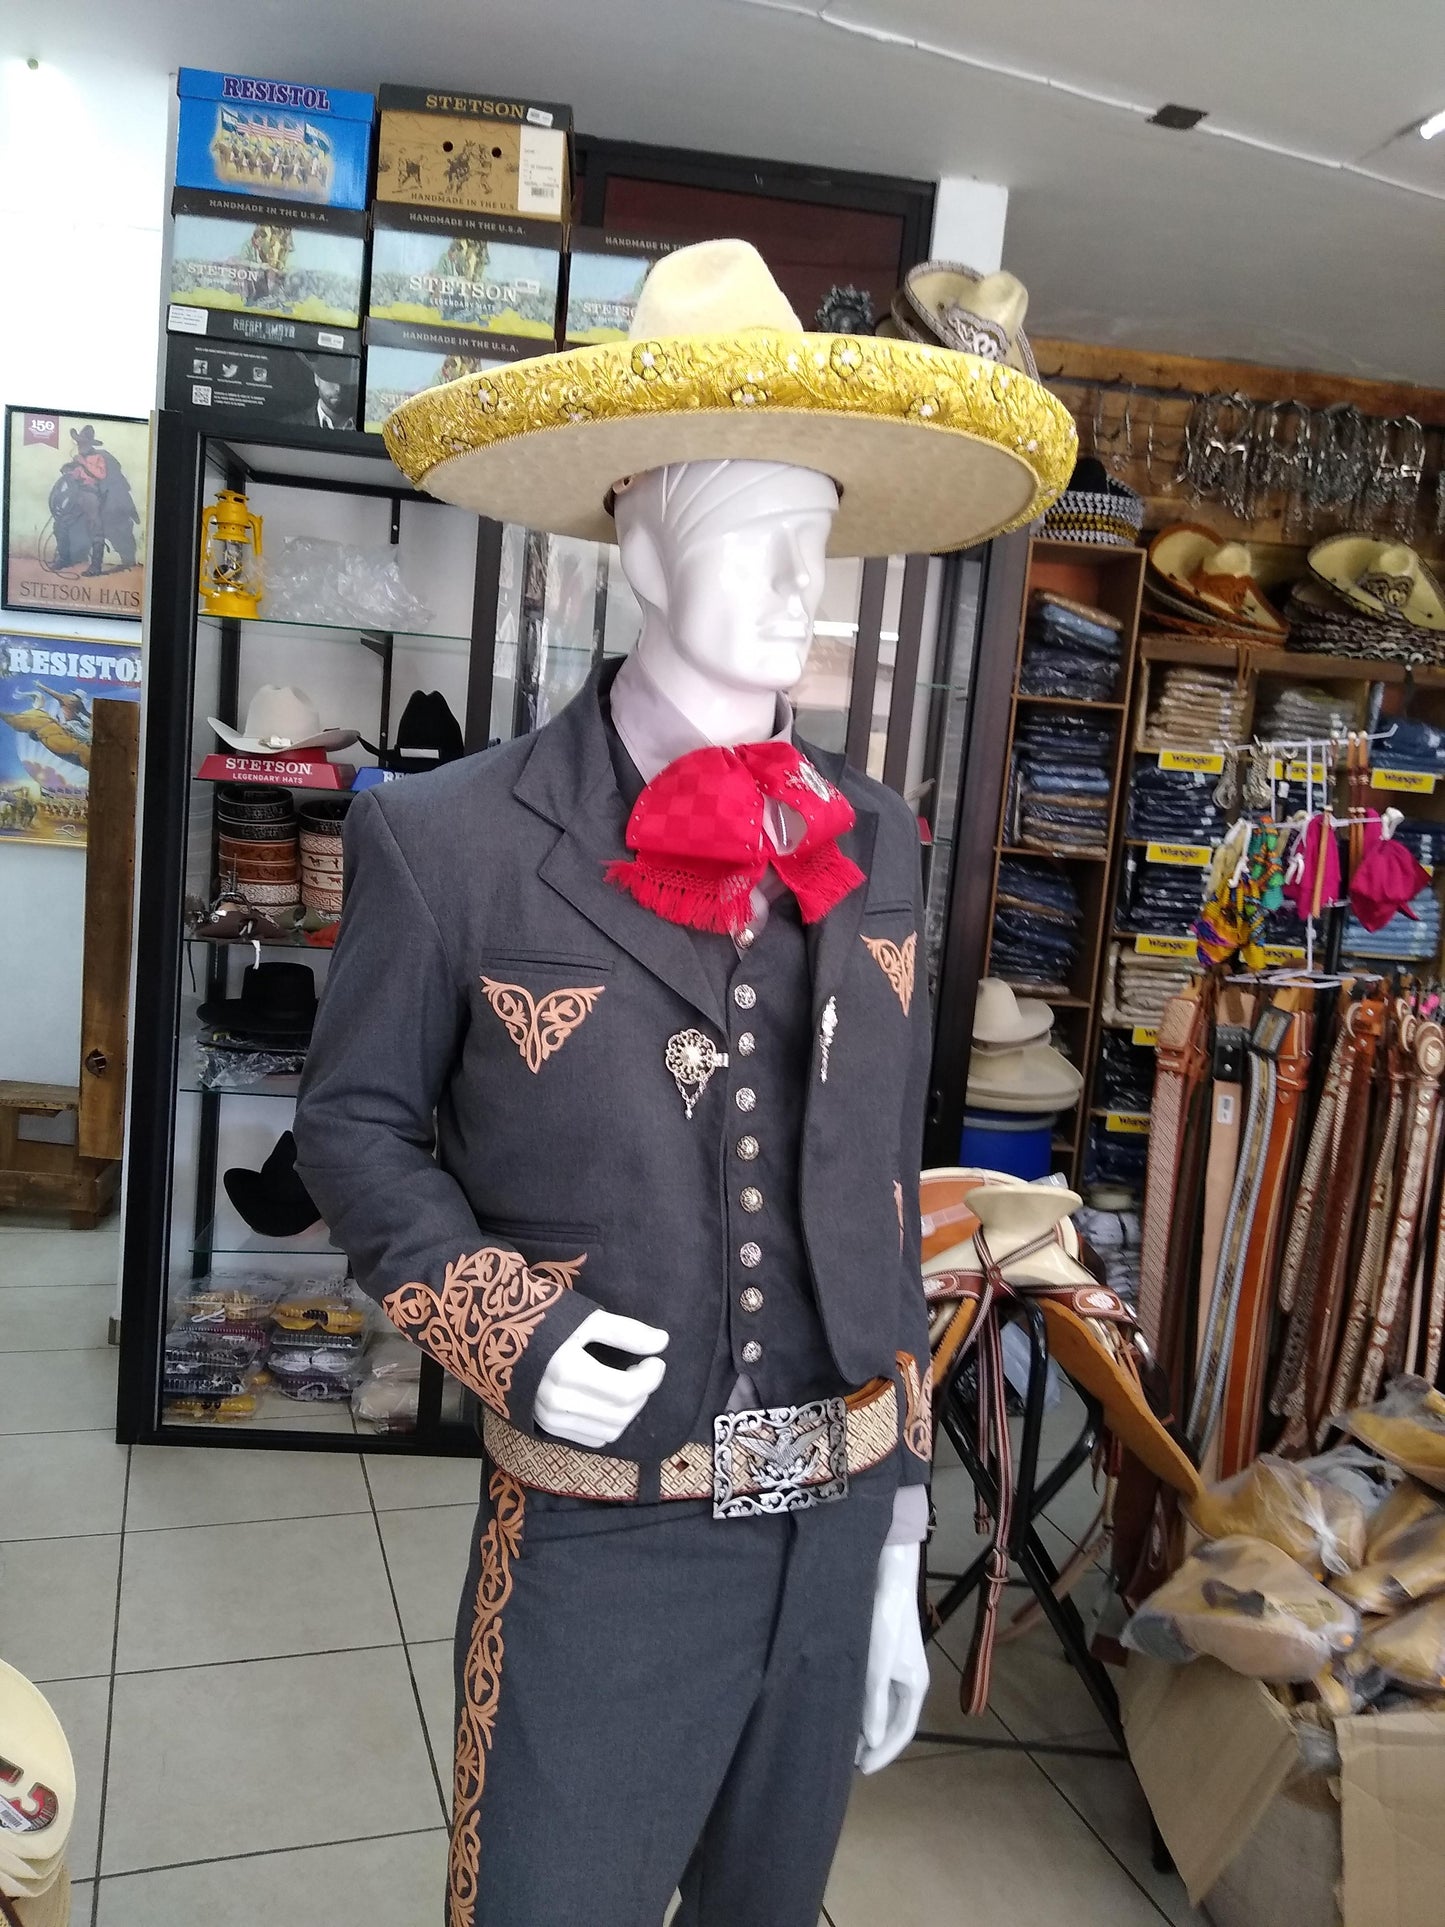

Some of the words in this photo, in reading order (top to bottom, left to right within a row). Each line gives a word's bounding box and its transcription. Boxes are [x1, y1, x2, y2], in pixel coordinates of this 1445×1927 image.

[222, 76, 330, 111] RESISTOL
[426, 94, 525, 119] STETSON
[411, 193, 464, 206] HANDMADE
[467, 199, 478, 207] IN
[480, 200, 497, 209] THE
[209, 200, 264, 213] HANDMADE
[266, 206, 277, 215] IN
[280, 208, 298, 218] THE
[301, 209, 329, 222] U.S.A.
[409, 213, 463, 226] HANDMADE
[465, 220, 476, 229] IN
[478, 222, 496, 231] THE
[498, 223, 526, 235] U.S.A.
[605, 236, 658, 250] HANDMADE
[660, 243, 671, 252] IN
[187, 263, 260, 282] STETSON
[409, 276, 518, 303] STETSON
[402, 331, 456, 345] HANDMADE
[458, 337, 469, 347] IN
[471, 339, 489, 349] THE
[492, 341, 519, 353] U.S.A.
[31, 419, 55, 432] 150
[20, 581, 92, 601] STETSON
[99, 588, 141, 607] HATS
[225, 757, 310, 775] STETSON
[232, 772, 280, 783] LEGENDARY
[283, 776, 303, 785] HATS
[1159, 846, 1200, 862] Wrangler
[1148, 938, 1187, 954] Wrangler
